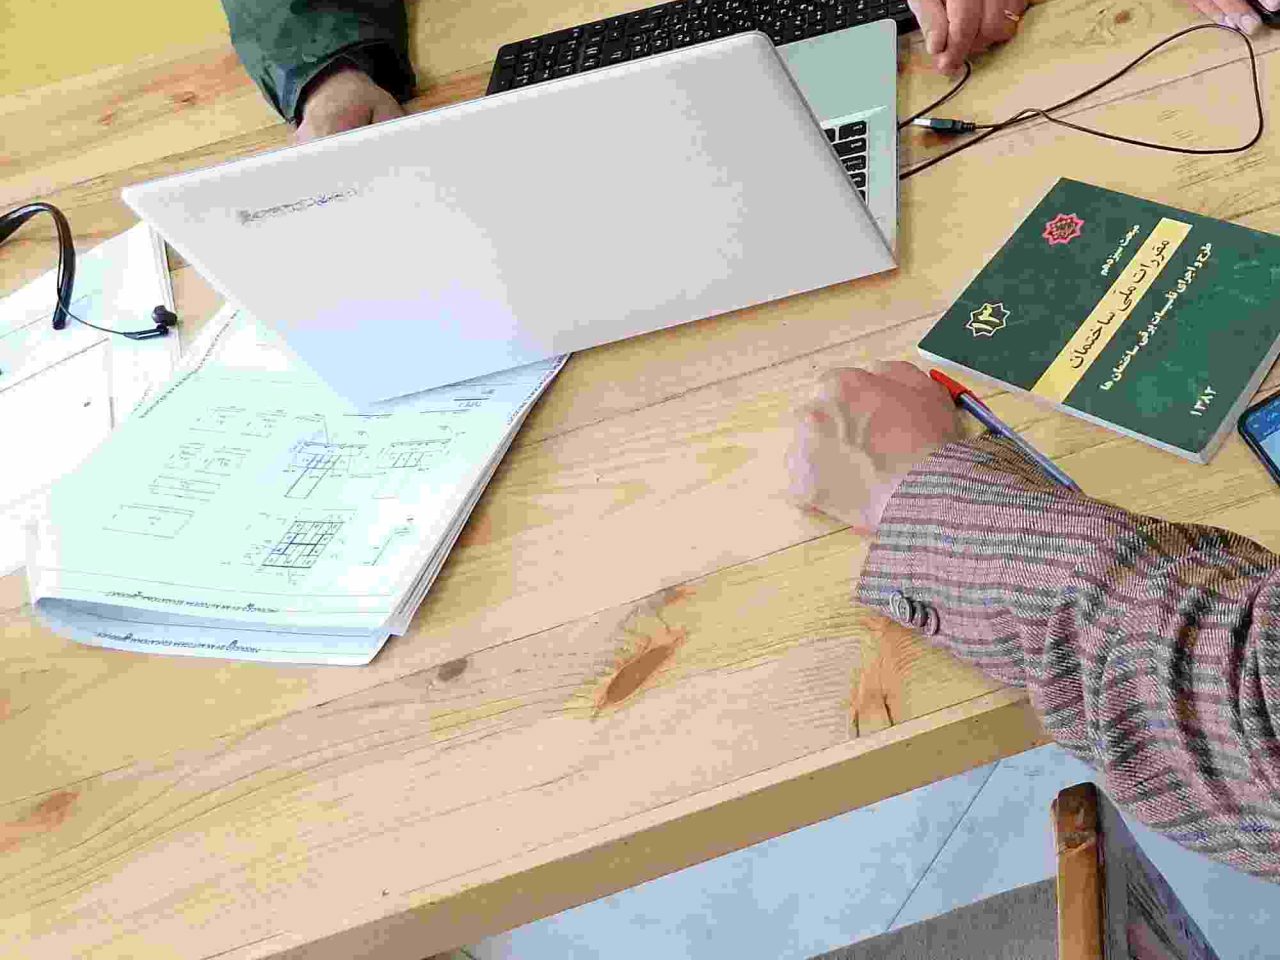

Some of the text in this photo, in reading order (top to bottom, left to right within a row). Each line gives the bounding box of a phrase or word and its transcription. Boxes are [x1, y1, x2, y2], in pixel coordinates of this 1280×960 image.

[1100, 224, 1140, 277] مبحث سیزدهم
[1132, 239, 1170, 284] مقررات
[1195, 242, 1212, 262] طرح
[1177, 266, 1197, 293] اجرای
[972, 304, 1000, 331] ۱۳
[1070, 311, 1115, 369] ساختمان
[1138, 324, 1158, 346] برقی
[1111, 344, 1140, 382] ساختمان
[1100, 380, 1114, 391] ها
